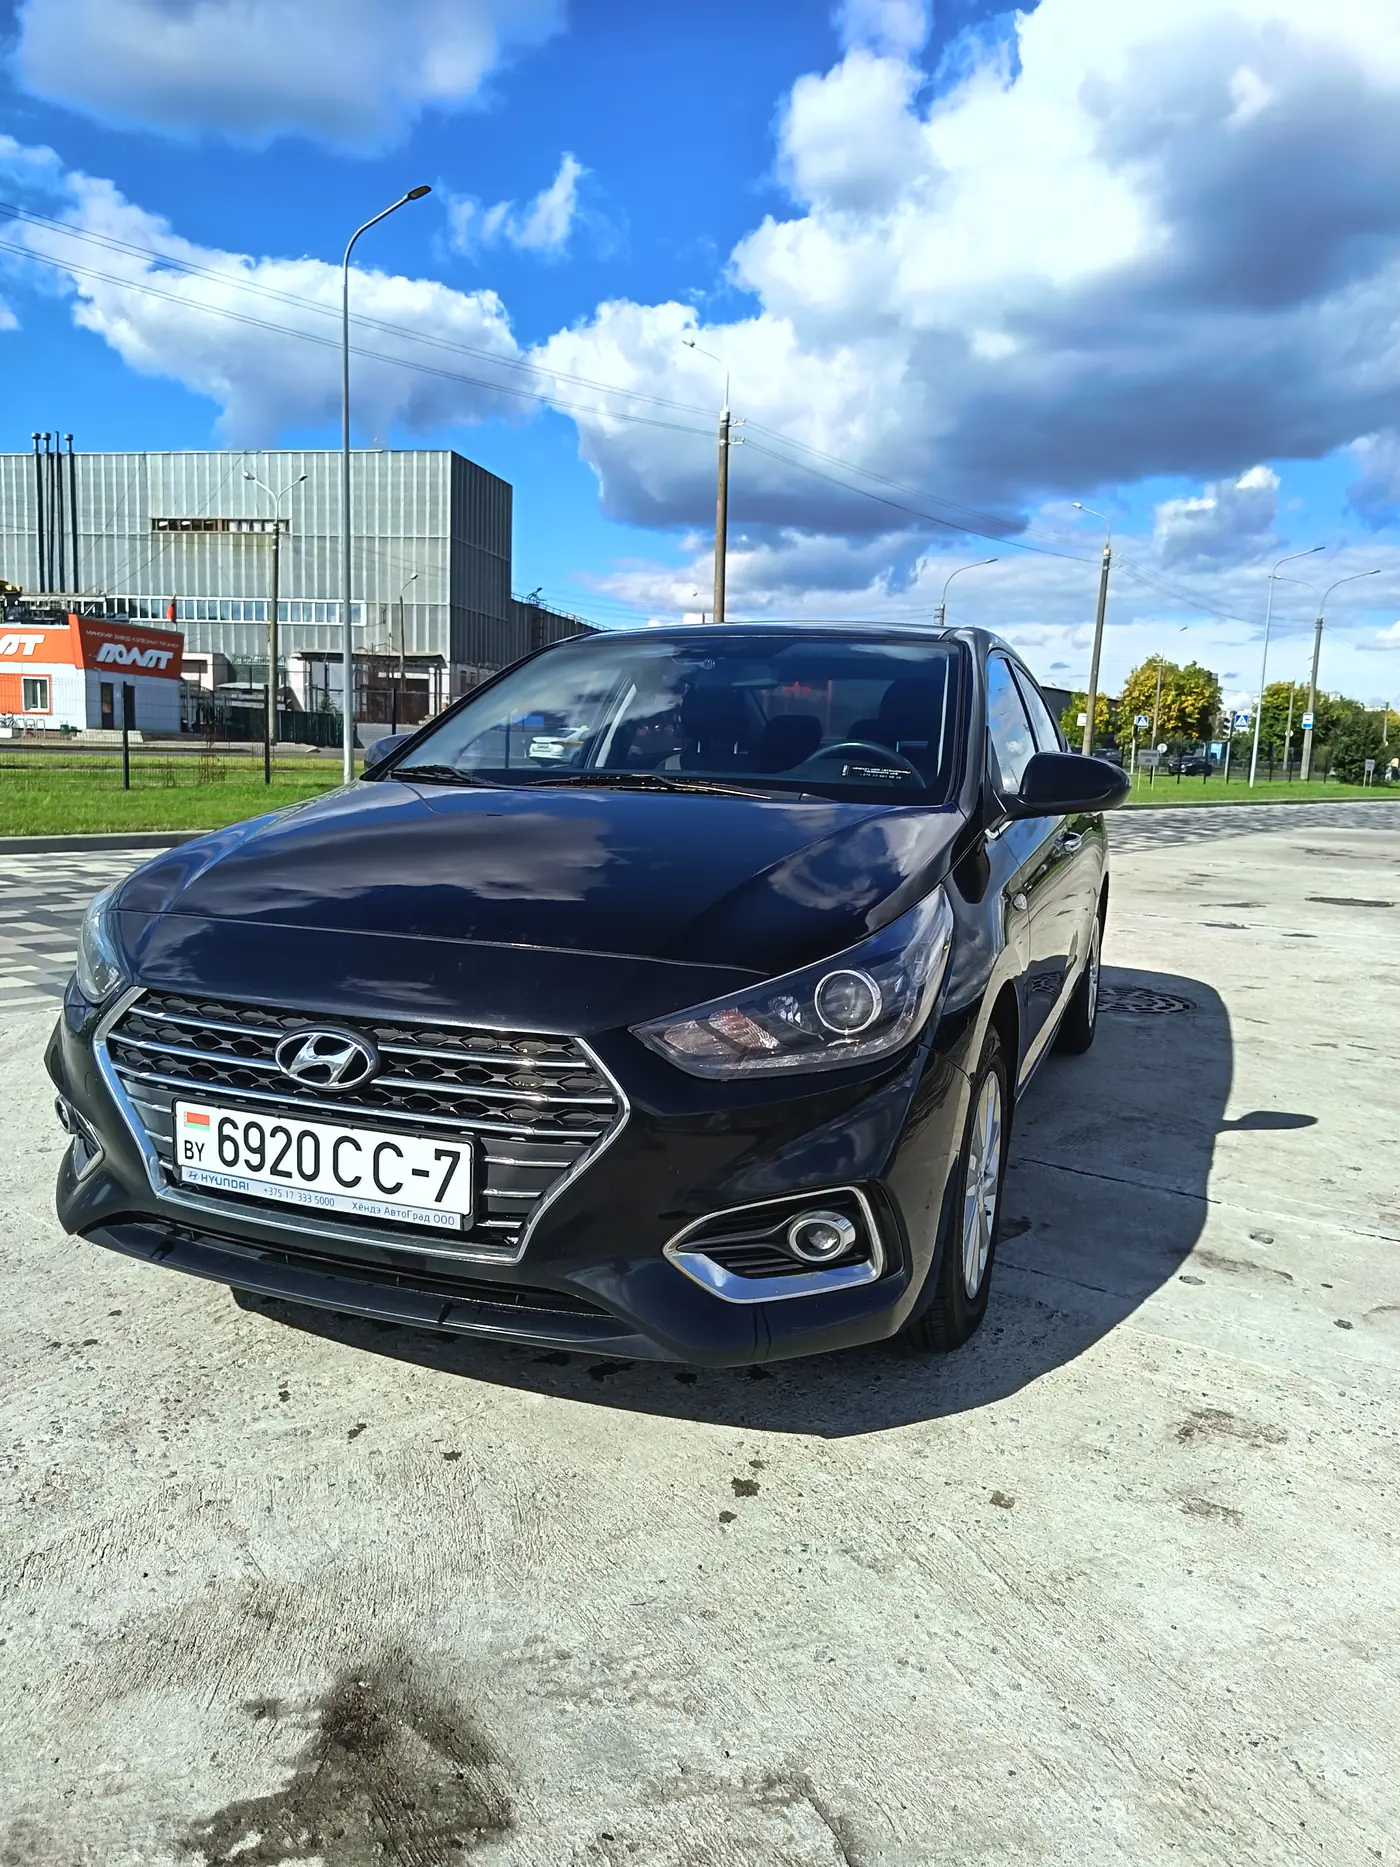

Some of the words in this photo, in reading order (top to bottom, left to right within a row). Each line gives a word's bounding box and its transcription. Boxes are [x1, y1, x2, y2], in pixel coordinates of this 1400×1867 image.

[184, 1139, 205, 1162] BY
[200, 1173, 249, 1191] HYUNDAI
[263, 1186, 283, 1198] +375
[285, 1190, 294, 1199] 17
[298, 1192, 312, 1203] 333
[314, 1195, 335, 1207] 5000
[383, 1206, 431, 1224] АвтоГрад
[433, 1213, 455, 1226] ООО
